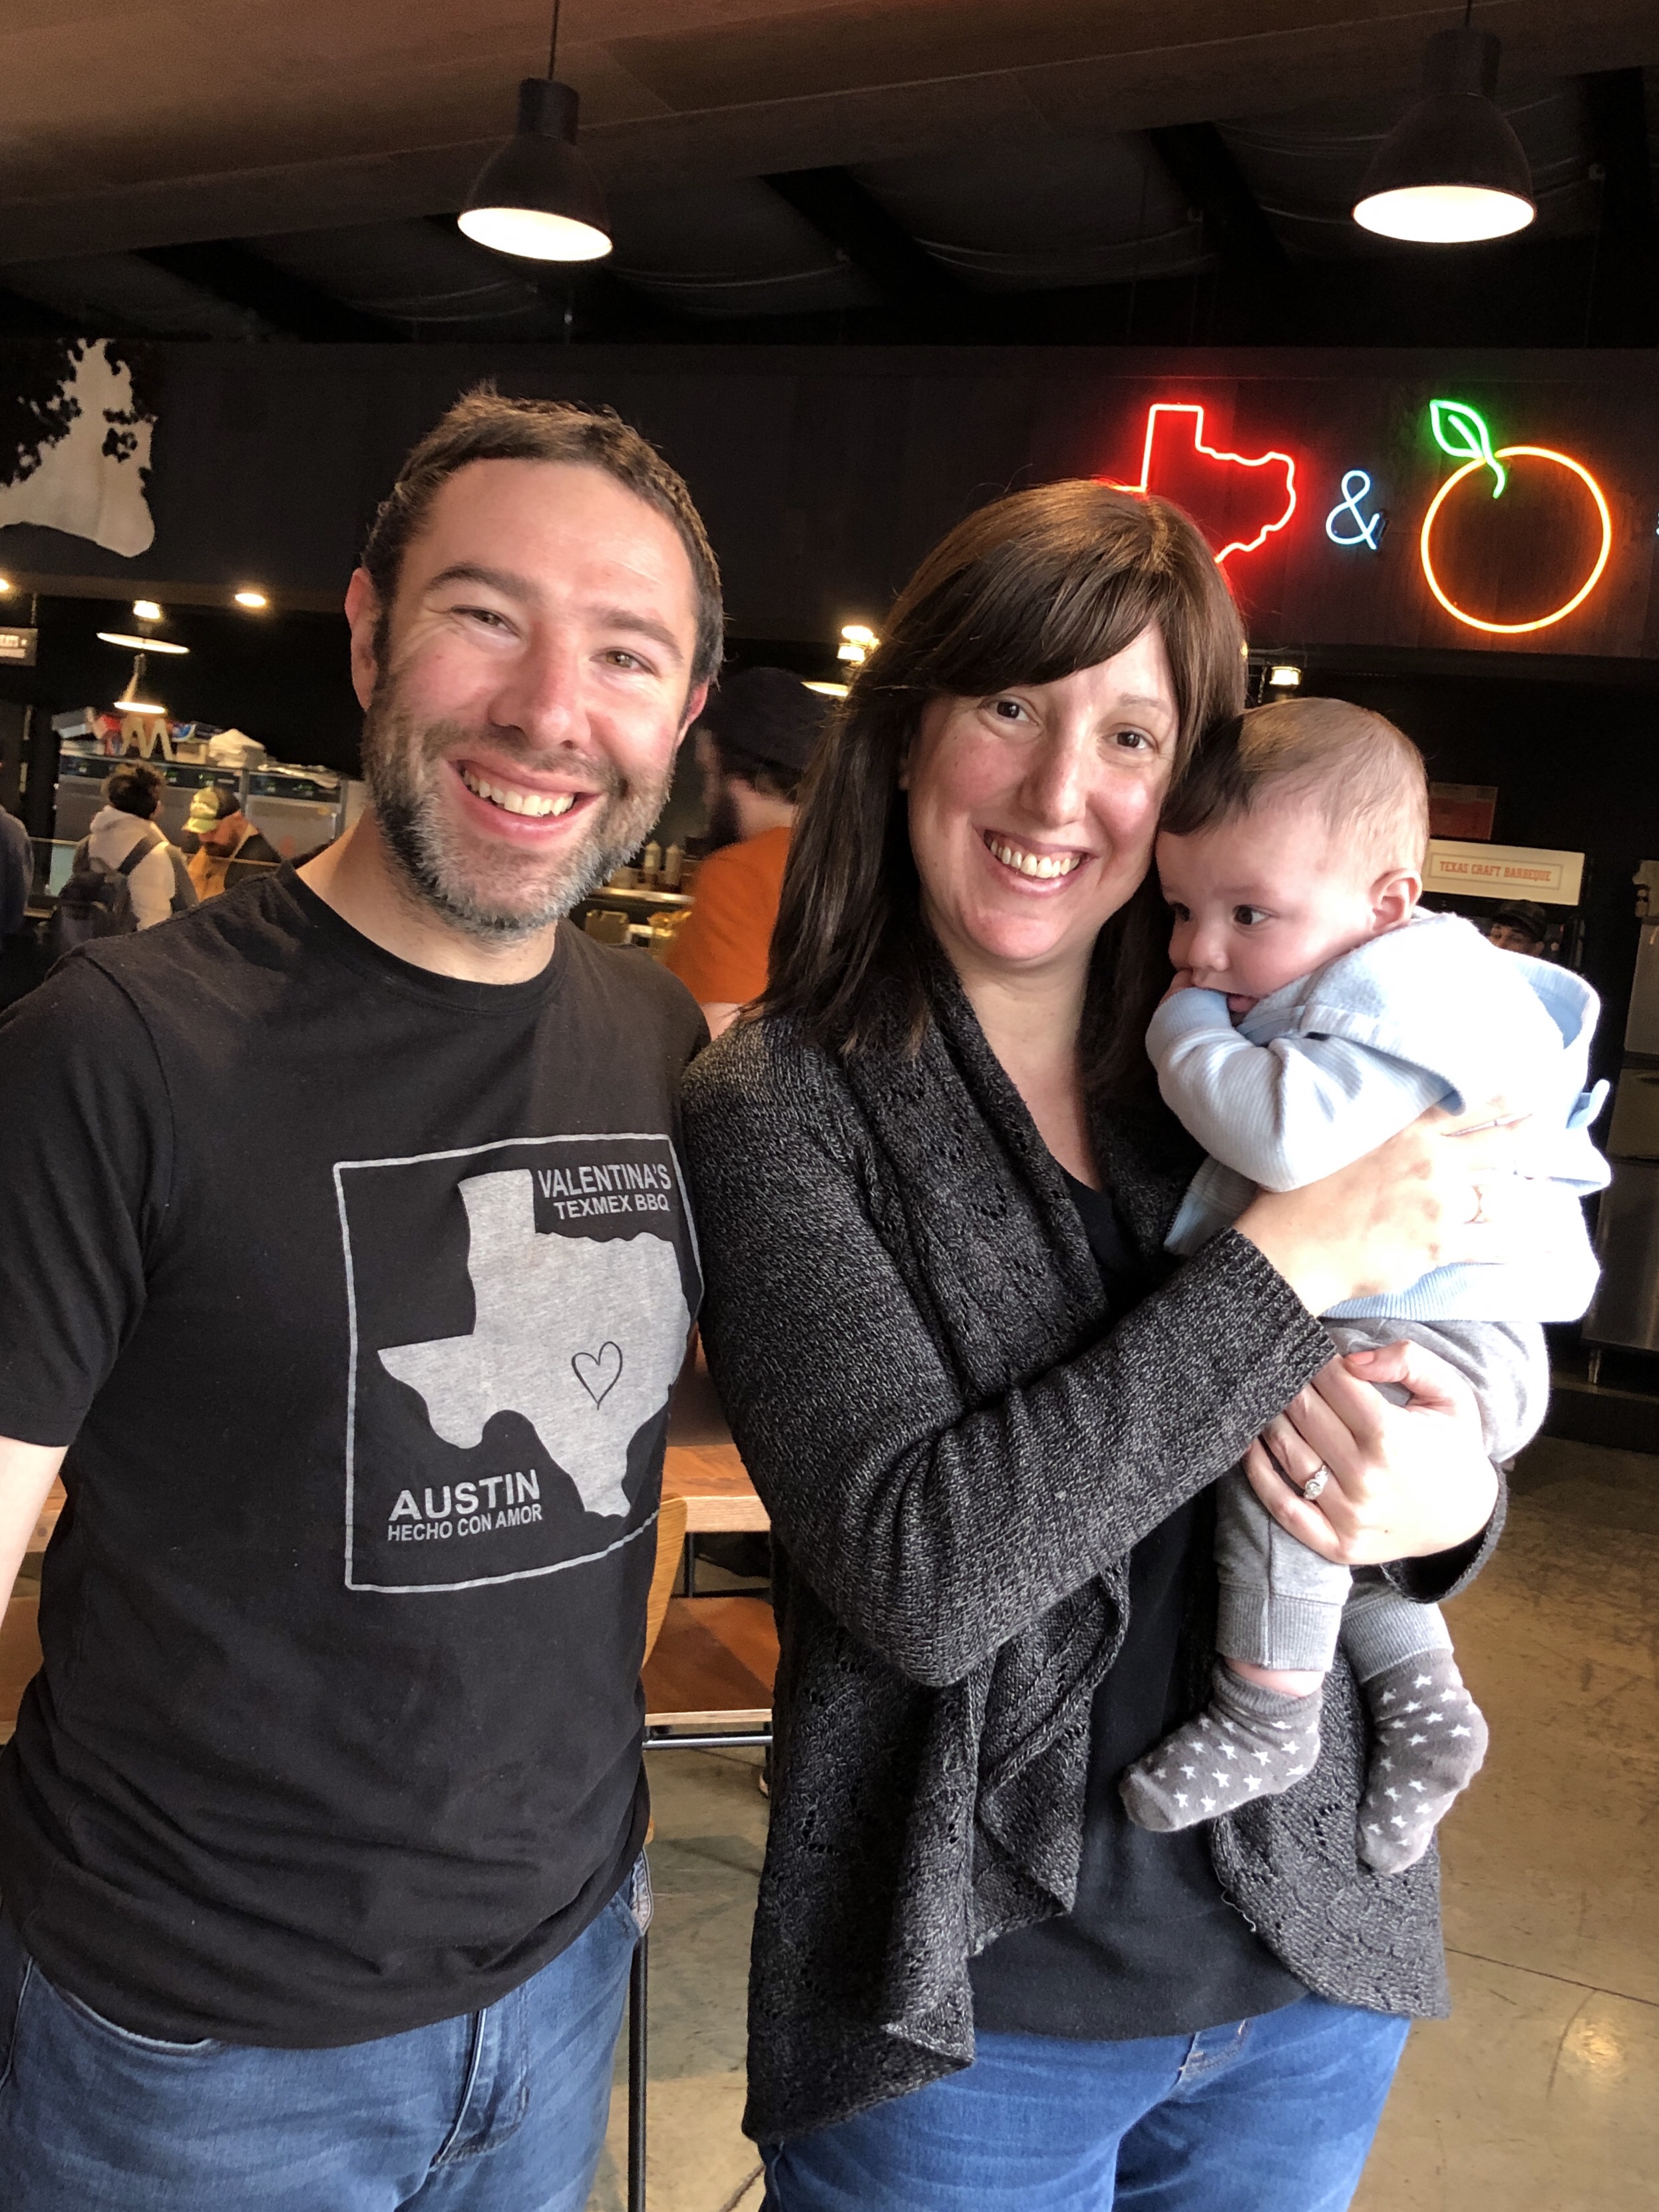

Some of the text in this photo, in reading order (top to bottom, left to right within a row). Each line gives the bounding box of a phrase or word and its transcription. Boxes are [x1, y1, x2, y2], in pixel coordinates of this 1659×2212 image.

[1439, 860, 1553, 882] TEXAS CRAFT BARBEQUE
[538, 1163, 672, 1198] VALENTINA'S
[553, 1193, 671, 1220] TEXMEX BBQ
[388, 1469, 540, 1521] AUSTIN
[387, 1503, 543, 1541] HECHO CON AMOR
